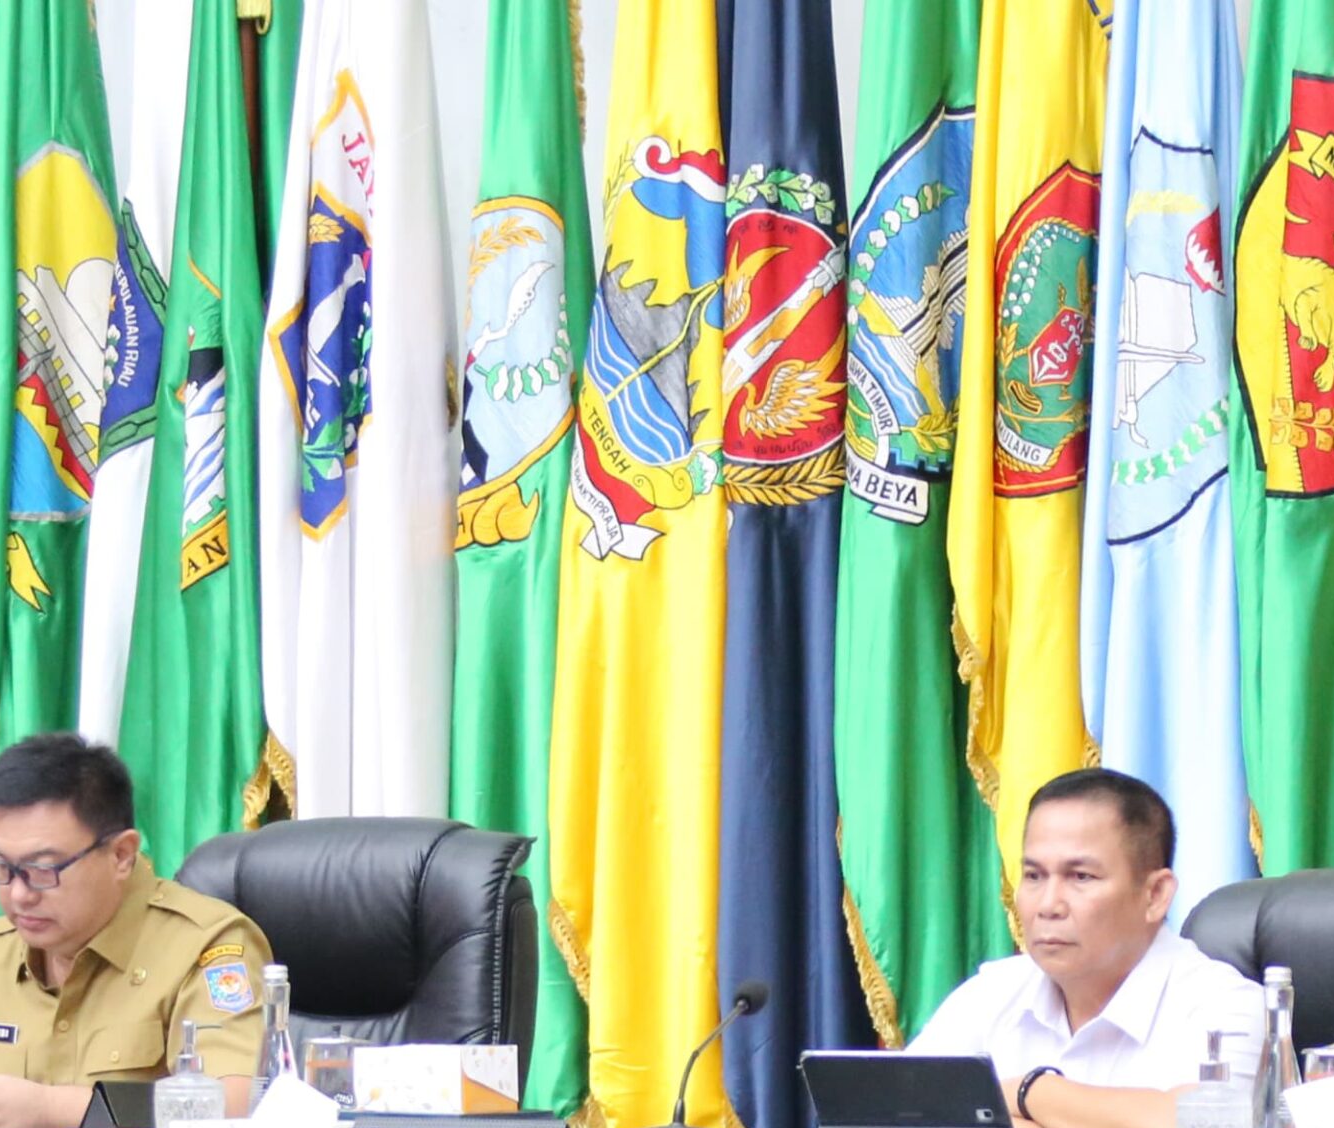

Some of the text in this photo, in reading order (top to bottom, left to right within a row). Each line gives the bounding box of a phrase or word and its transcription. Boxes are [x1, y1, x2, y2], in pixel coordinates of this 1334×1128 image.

[117, 349, 139, 388] RIAU
[866, 381, 893, 431] TIMUR
[587, 407, 631, 474] TENGAH
[865, 473, 918, 506] BEYA
